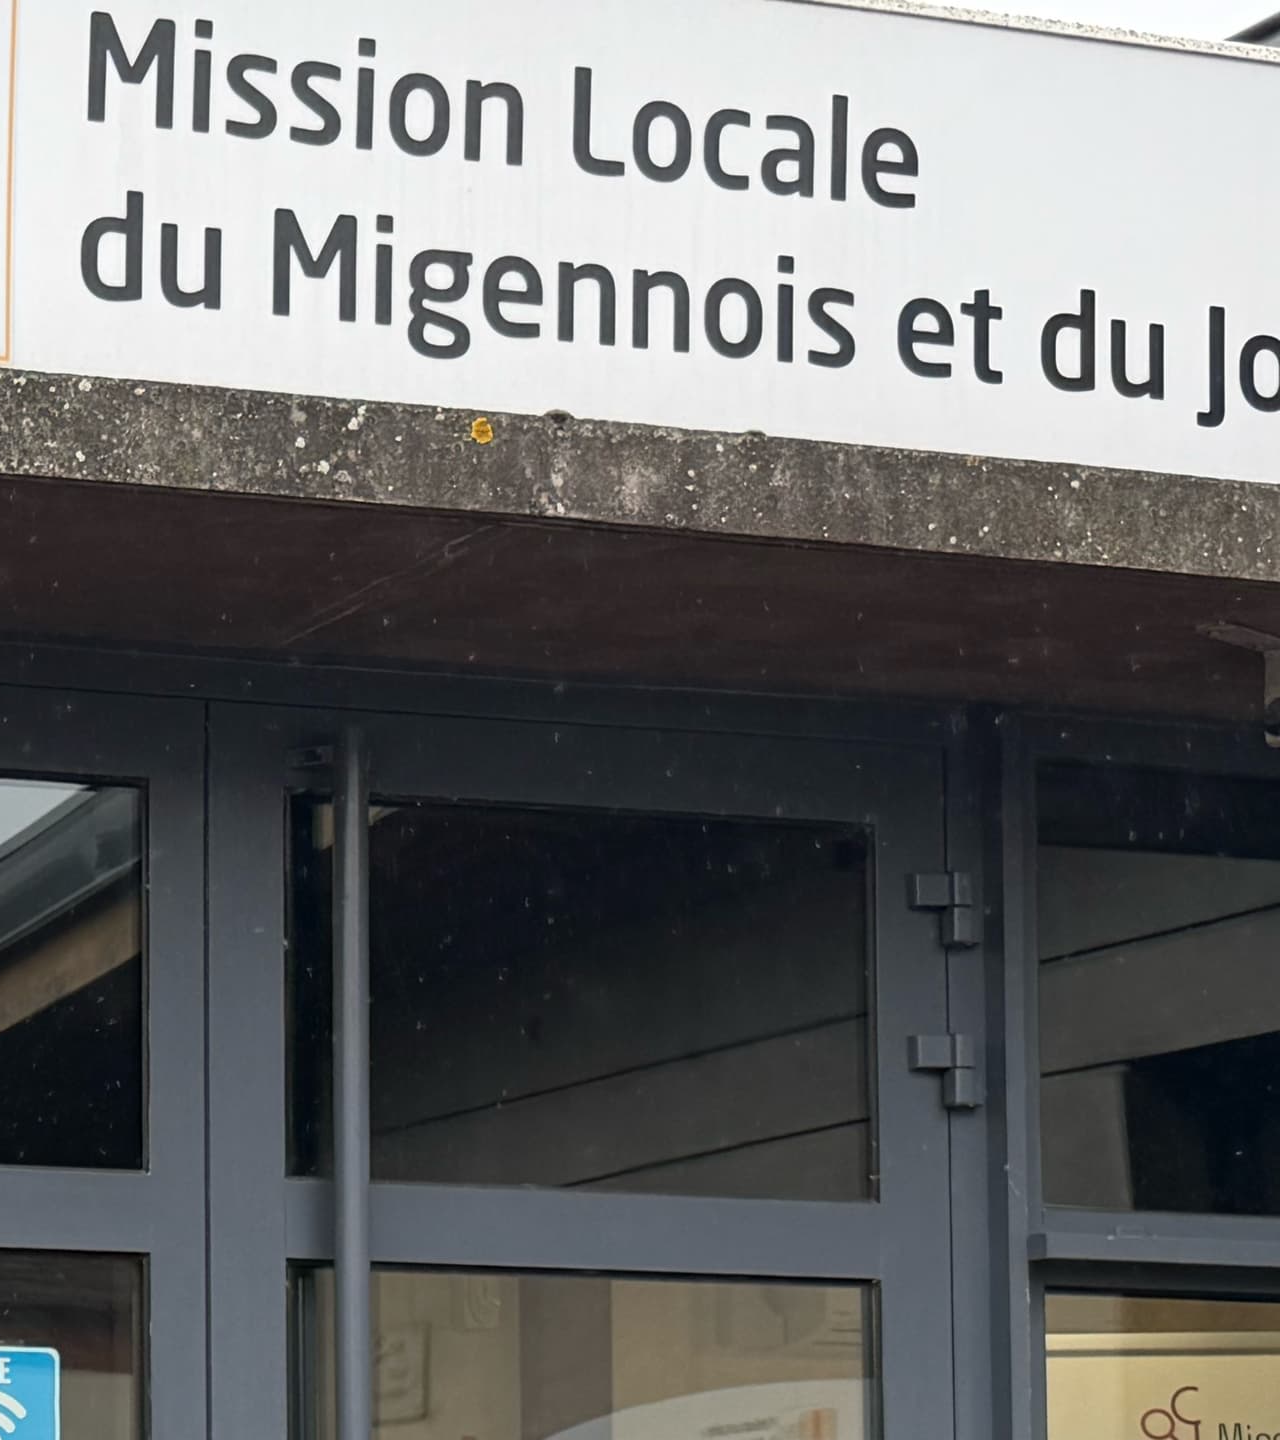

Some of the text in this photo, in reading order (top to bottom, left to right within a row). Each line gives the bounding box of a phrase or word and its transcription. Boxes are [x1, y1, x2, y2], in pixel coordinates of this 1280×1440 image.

[86, 11, 921, 210] Mission Locale
[79, 190, 224, 312] du
[272, 207, 857, 369] Migennois
[897, 287, 1005, 386] et
[1041, 287, 1167, 401] du
